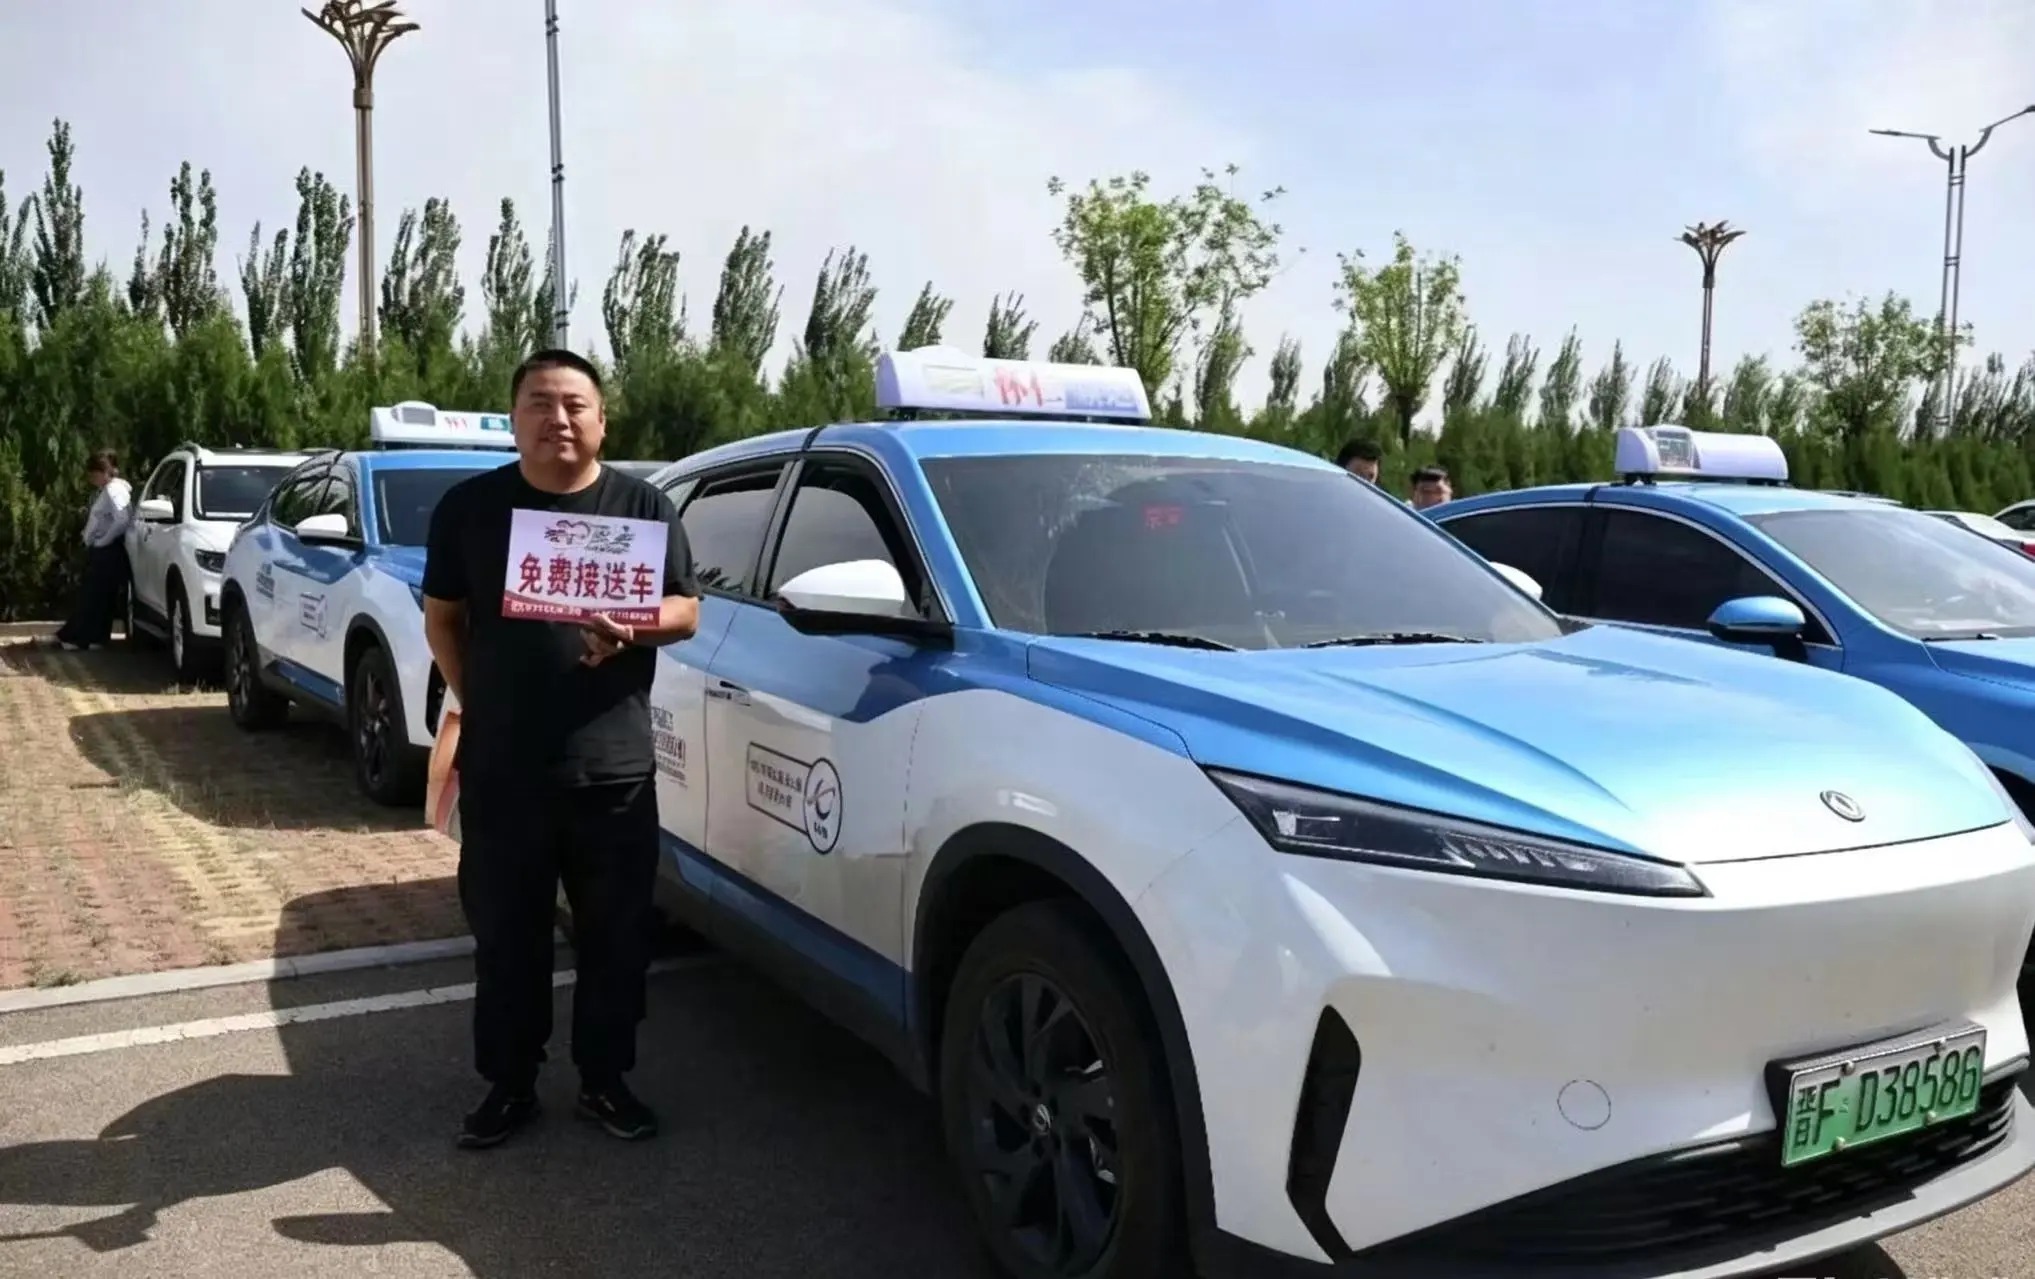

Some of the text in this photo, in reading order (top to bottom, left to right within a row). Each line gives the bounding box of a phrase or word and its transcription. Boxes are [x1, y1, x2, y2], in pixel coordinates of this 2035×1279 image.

[519, 553, 655, 603] 免费接送车
